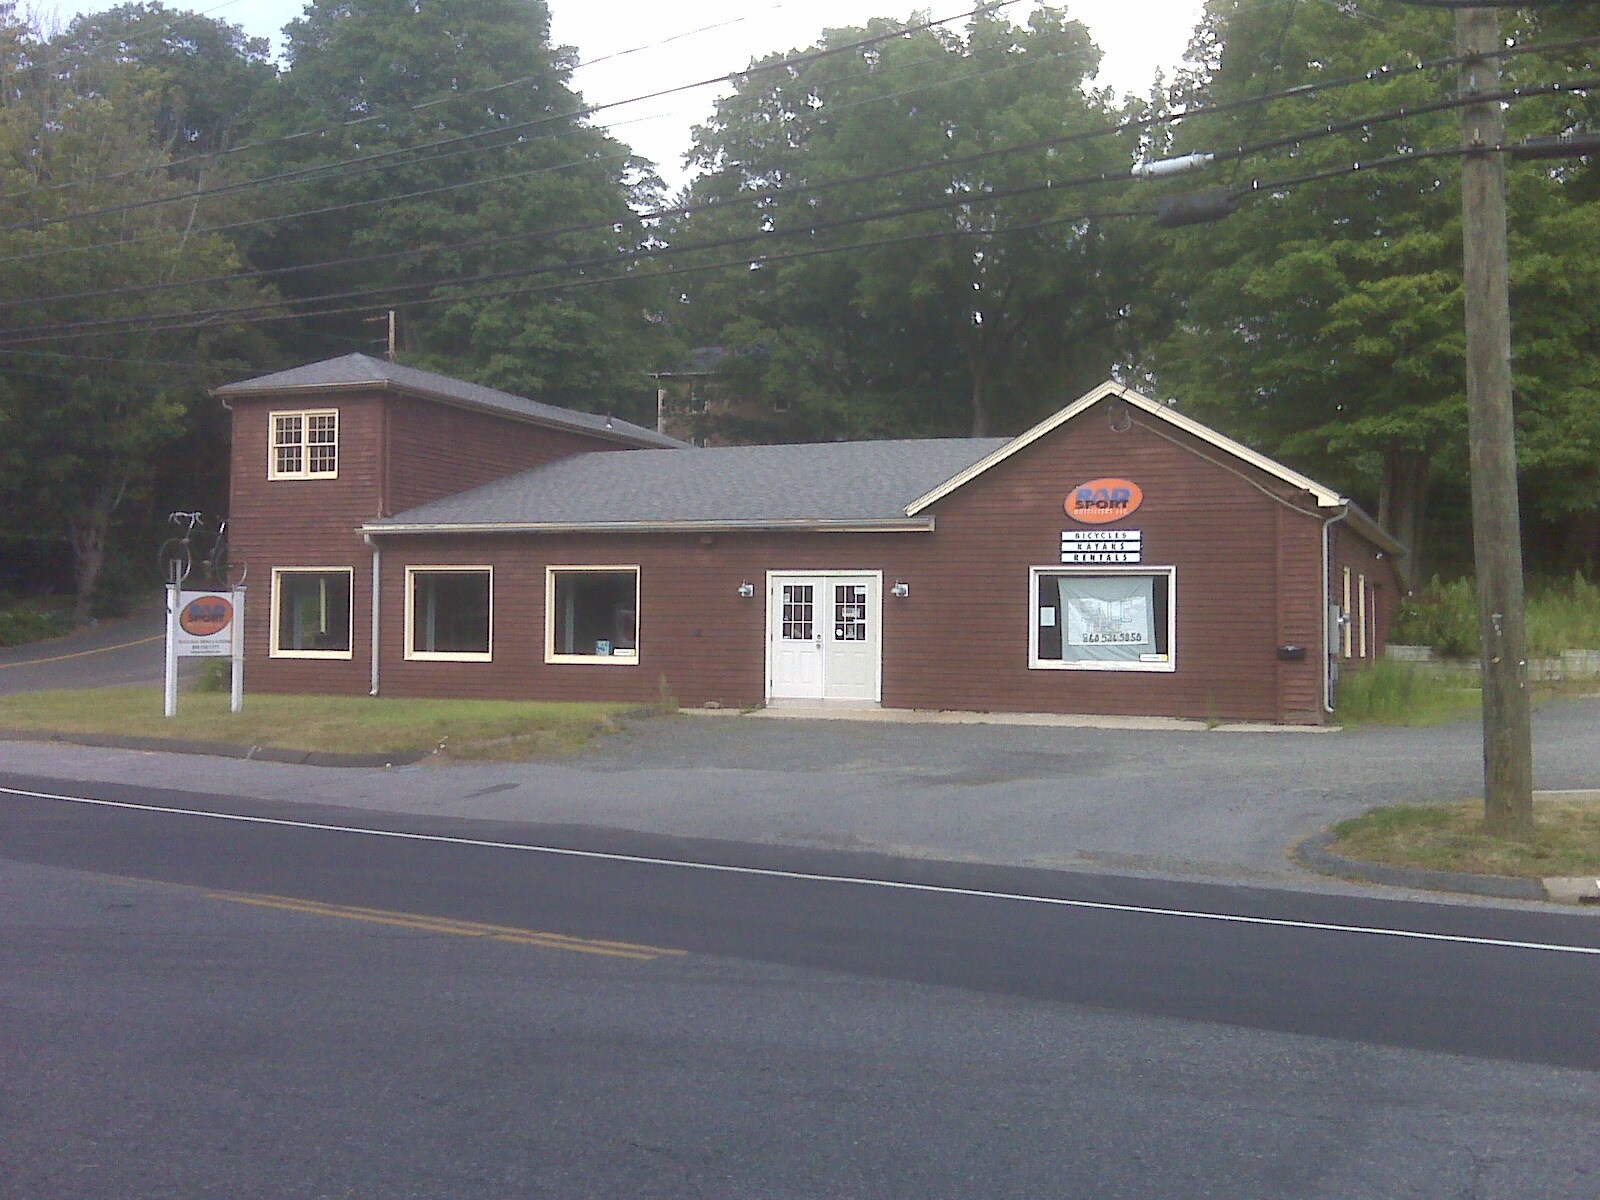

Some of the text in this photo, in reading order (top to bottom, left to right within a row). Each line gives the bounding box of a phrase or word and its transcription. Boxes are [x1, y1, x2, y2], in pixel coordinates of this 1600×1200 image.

[1075, 500, 1129, 509] SPORT
[1077, 542, 1125, 550] KAYAKS
[1073, 553, 1127, 561] RENTALS
